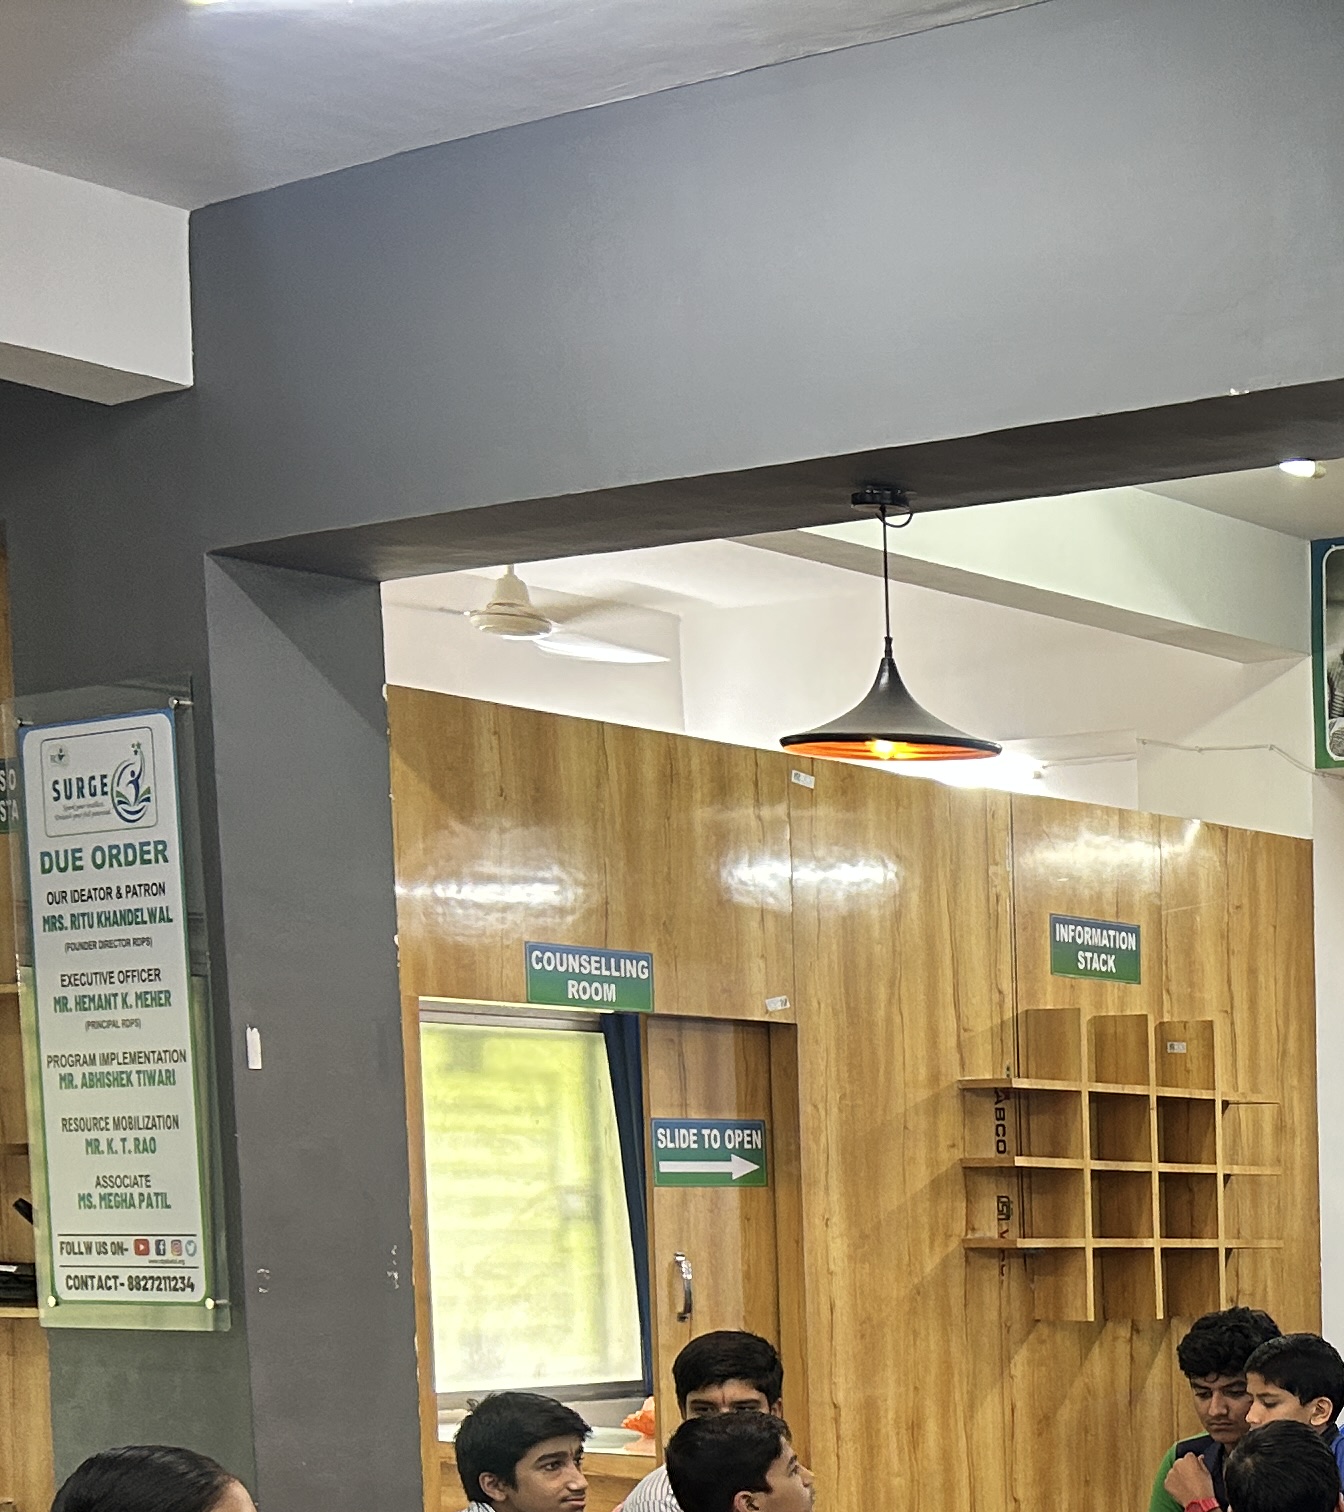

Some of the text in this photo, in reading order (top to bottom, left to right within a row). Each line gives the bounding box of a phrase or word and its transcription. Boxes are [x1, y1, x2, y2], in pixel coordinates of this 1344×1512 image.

[52, 774, 109, 802] SURGE
[40, 840, 169, 875] DUE ORDER
[47, 881, 166, 906] OUR IDEATOR & PATRON
[43, 914, 68, 933] MRS.
[70, 911, 95, 931] RITU
[1055, 922, 1136, 951] INFORMATION
[531, 950, 650, 979] COUNSELLING
[1077, 950, 1117, 973] STACK
[60, 968, 161, 988] EXECUTIVE OFFICER
[53, 989, 172, 1013] MR. HEMANT K. MEHER
[567, 980, 617, 1003] ROOM
[47, 1049, 187, 1068] PROGRAM IMPLEMENTATION
[59, 1068, 176, 1090] MR. ABHISHEK TIWARI
[61, 1114, 180, 1132] RESOURCE MOBILIZATION
[85, 1138, 104, 1155] MR.
[106, 1138, 119, 1154] K.
[133, 1136, 157, 1153] RAO
[657, 1128, 763, 1149] SLIDE TO OPEN
[95, 1174, 151, 1189] ASSOCIATE
[77, 1192, 171, 1210] MS. MEGHA PATIL
[95, 1241, 108, 1255] US
[127, 1275, 195, 1292] 8827211234
